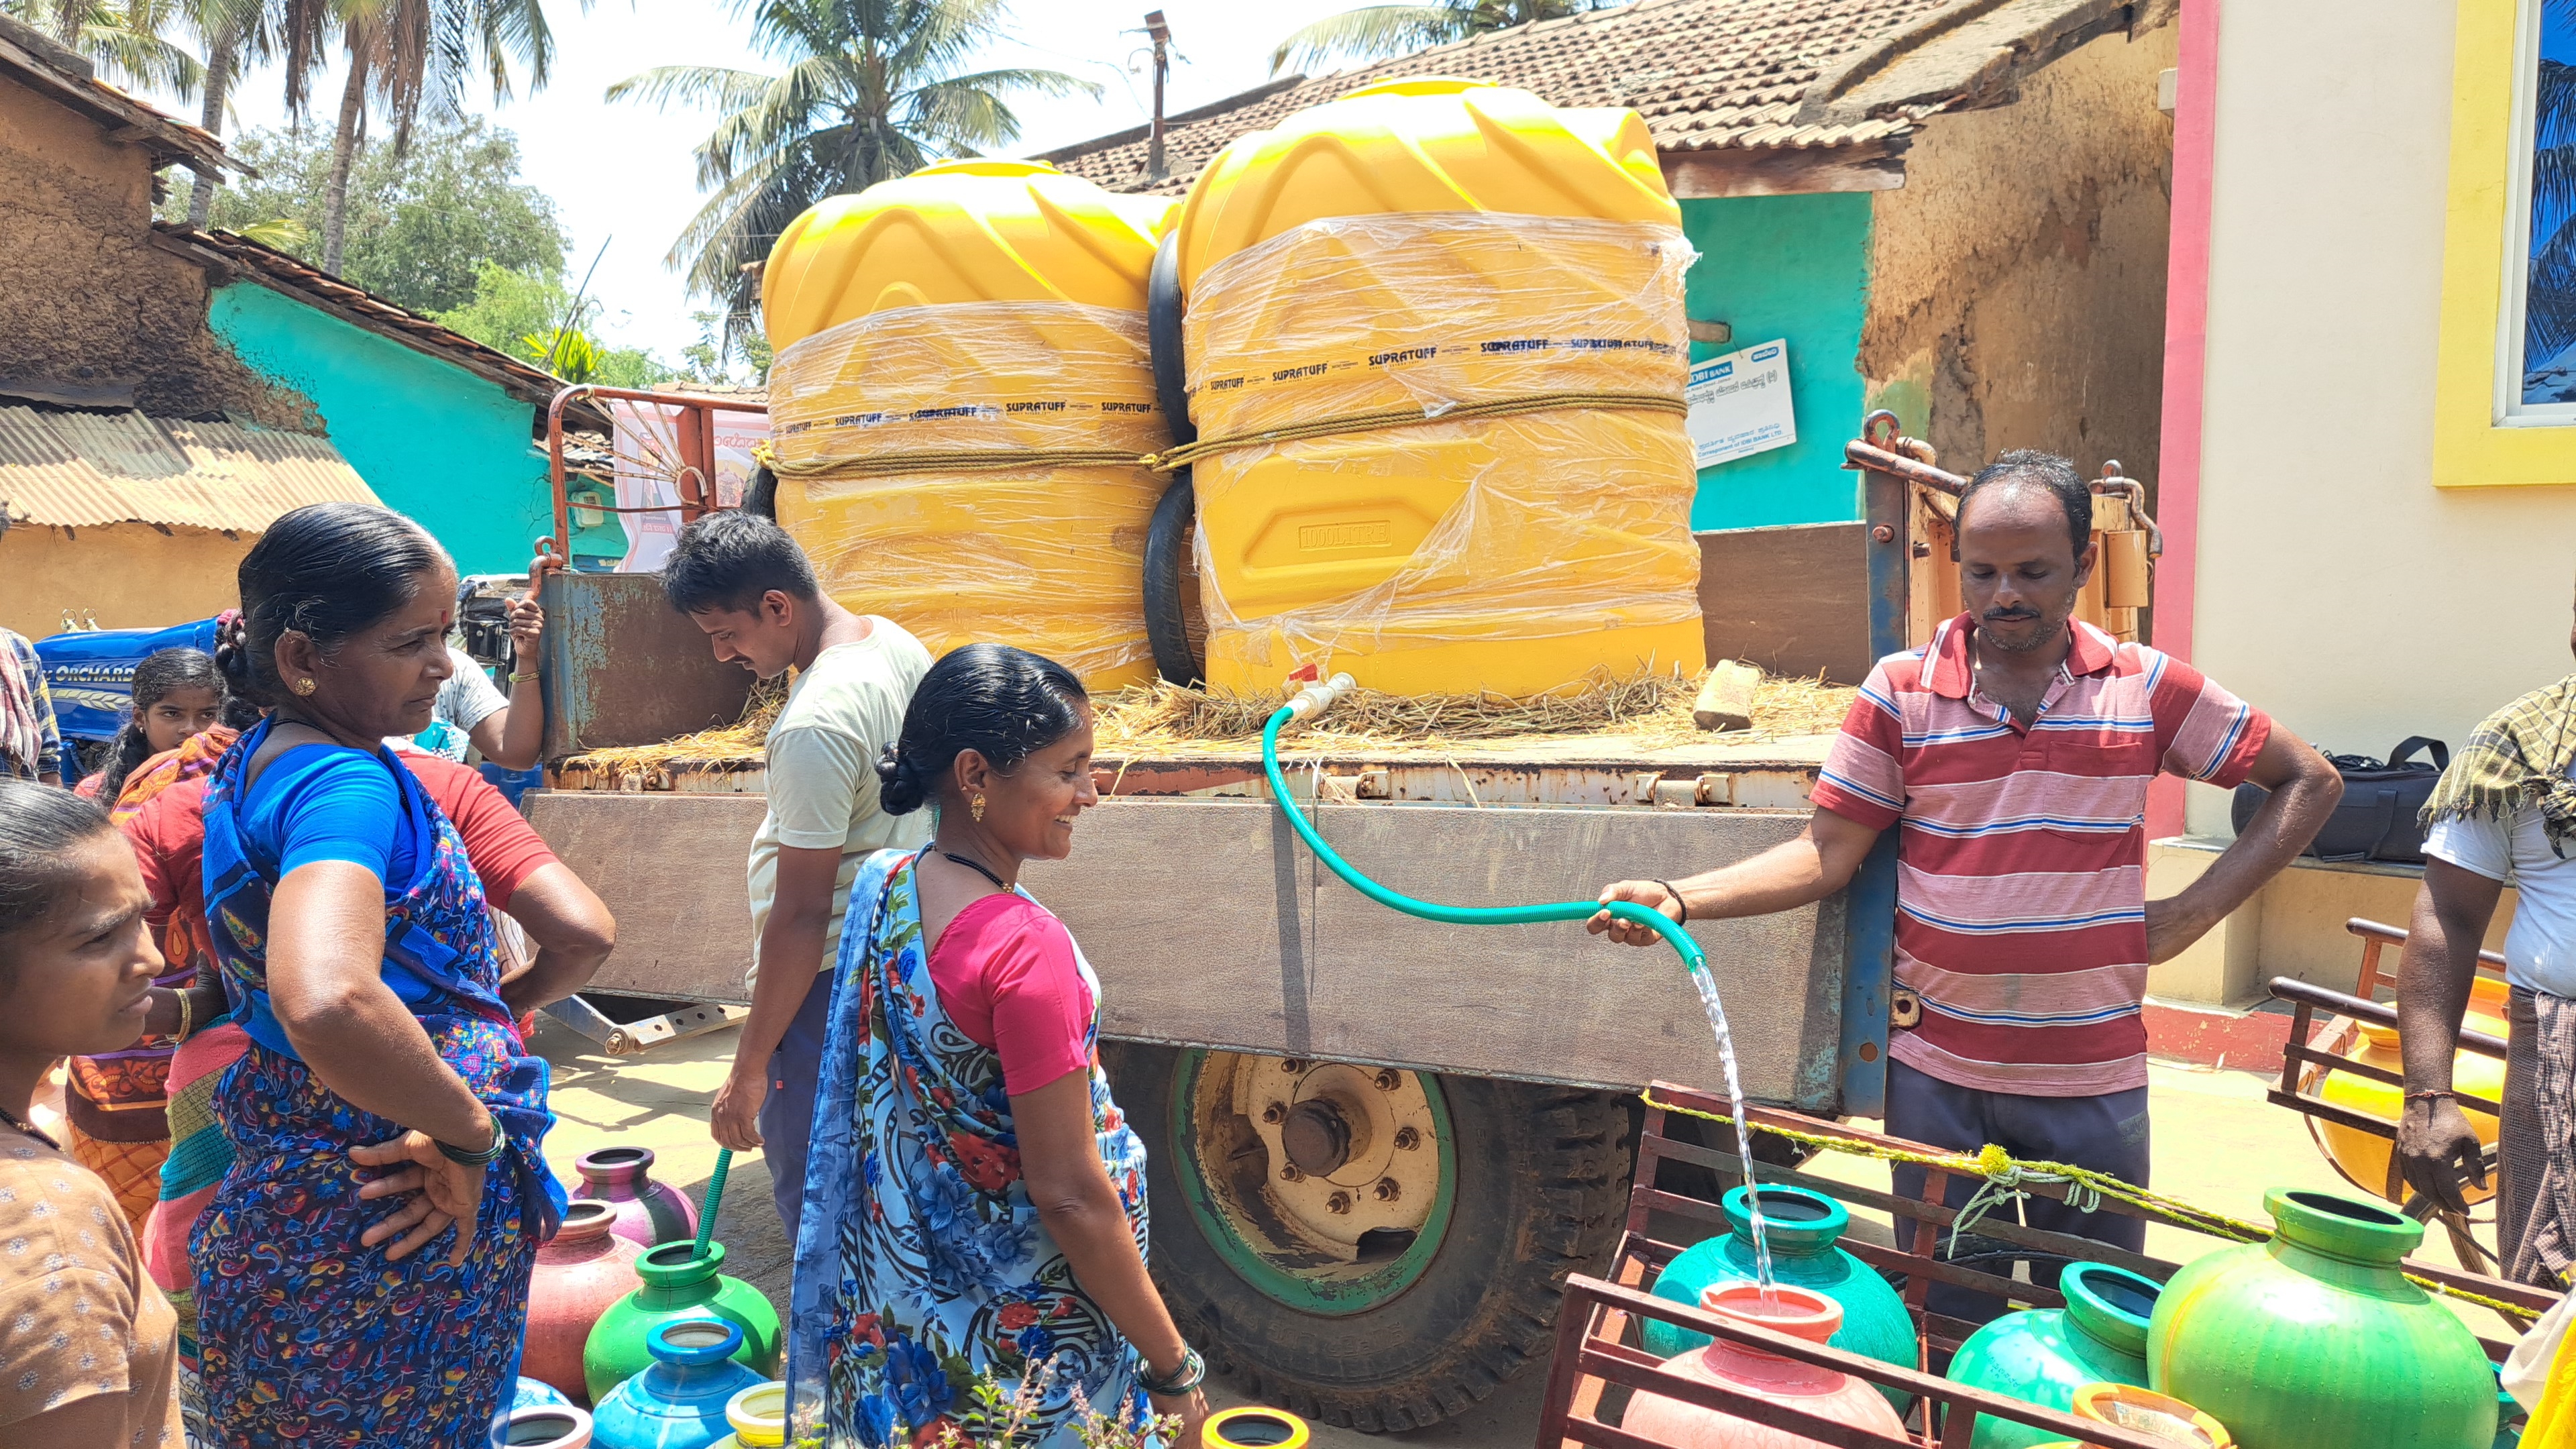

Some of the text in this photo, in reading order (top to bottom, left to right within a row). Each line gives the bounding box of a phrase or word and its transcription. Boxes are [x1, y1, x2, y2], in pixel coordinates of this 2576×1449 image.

[1368, 347, 1437, 366] SUPRATUFF
[1272, 363, 1328, 382] SUPRATUFF
[1709, 365, 1731, 378] BANK
[1210, 377, 1244, 391] SUPRATUFF
[1006, 401, 1066, 412] SUPRATUFF
[1101, 402, 1152, 413] SUPRATUFF
[835, 413, 883, 427] SUPRATUFF
[786, 421, 812, 434] SUPRATUFF
[1753, 433, 1769, 442] BANK
[56, 665, 136, 682] ORCHARD
